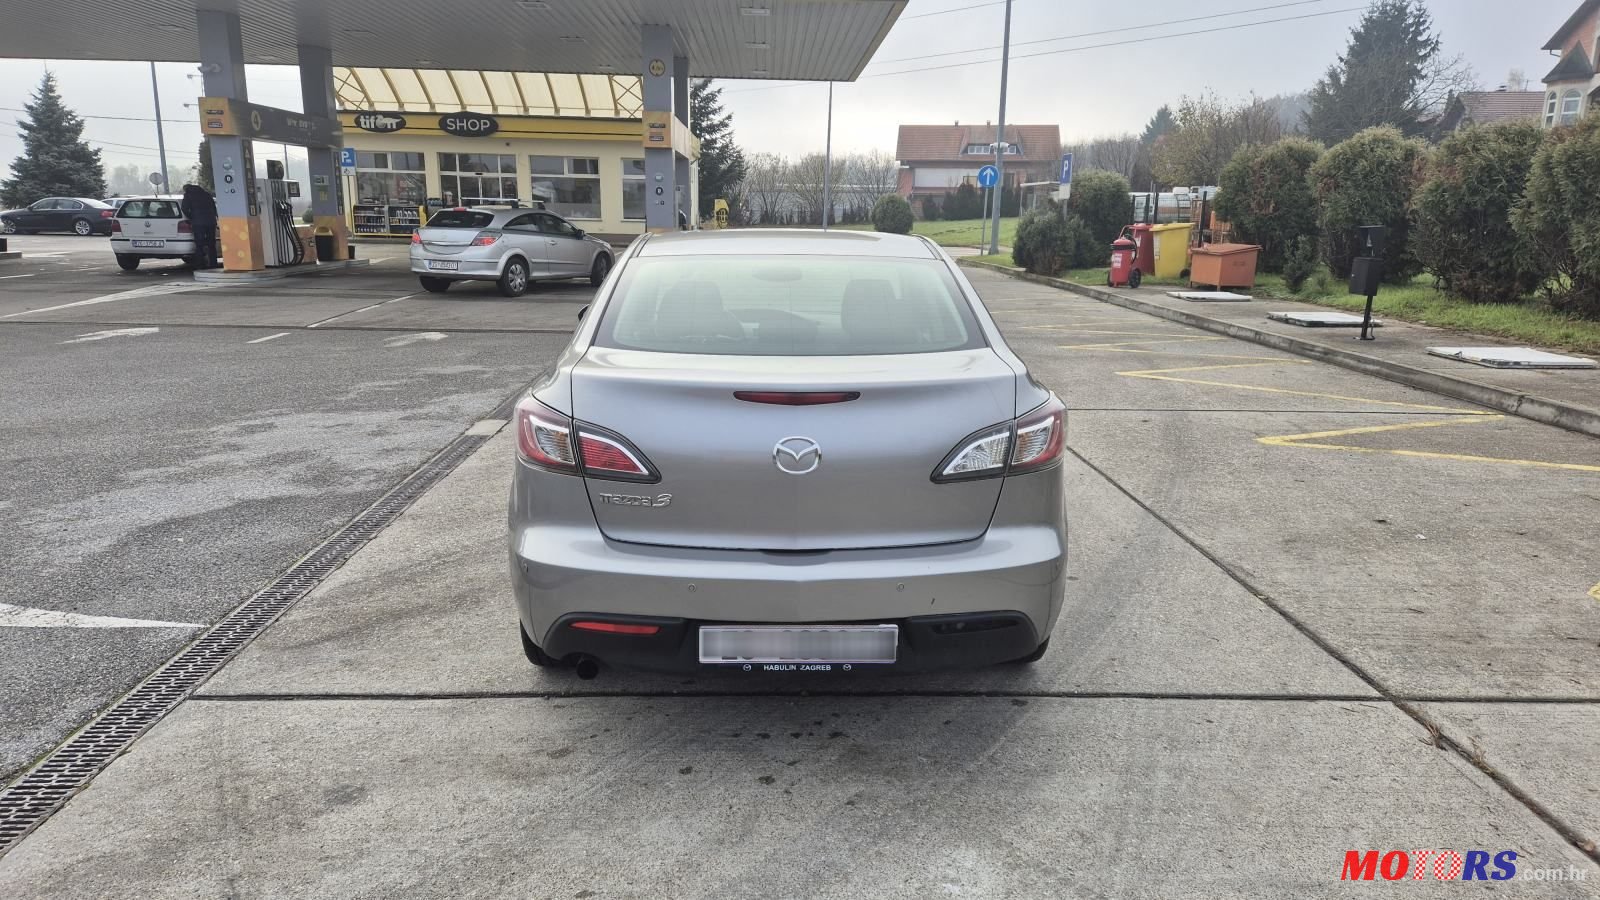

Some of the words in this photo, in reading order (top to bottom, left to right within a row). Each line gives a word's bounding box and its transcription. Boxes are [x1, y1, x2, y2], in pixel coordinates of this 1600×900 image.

[446, 118, 491, 131] SHOP
[341, 151, 350, 163] P
[1062, 159, 1069, 179] P
